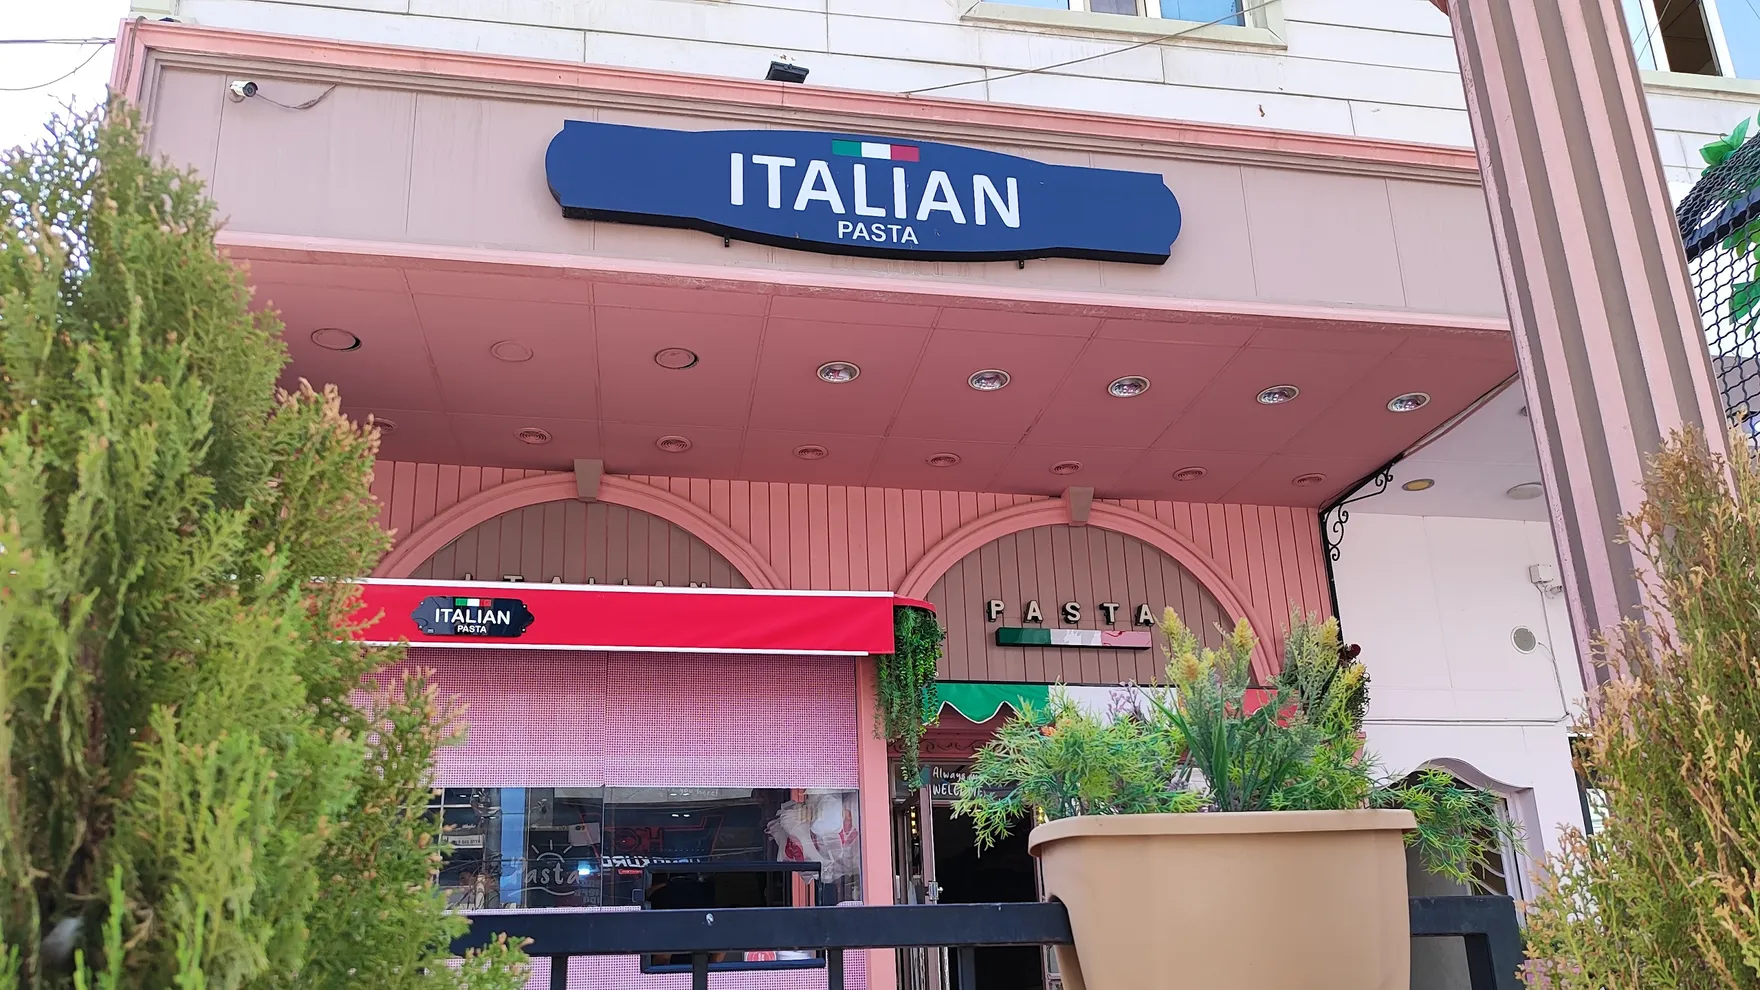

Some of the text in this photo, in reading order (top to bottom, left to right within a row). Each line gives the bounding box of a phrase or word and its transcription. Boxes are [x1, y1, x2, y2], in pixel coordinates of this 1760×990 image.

[730, 153, 1020, 228] ITALIAN
[838, 220, 919, 245] PASTA
[435, 608, 511, 625] ITALIAN
[987, 599, 1156, 626] PASTA
[457, 624, 488, 634] PASTA
[932, 766, 966, 782] Always
